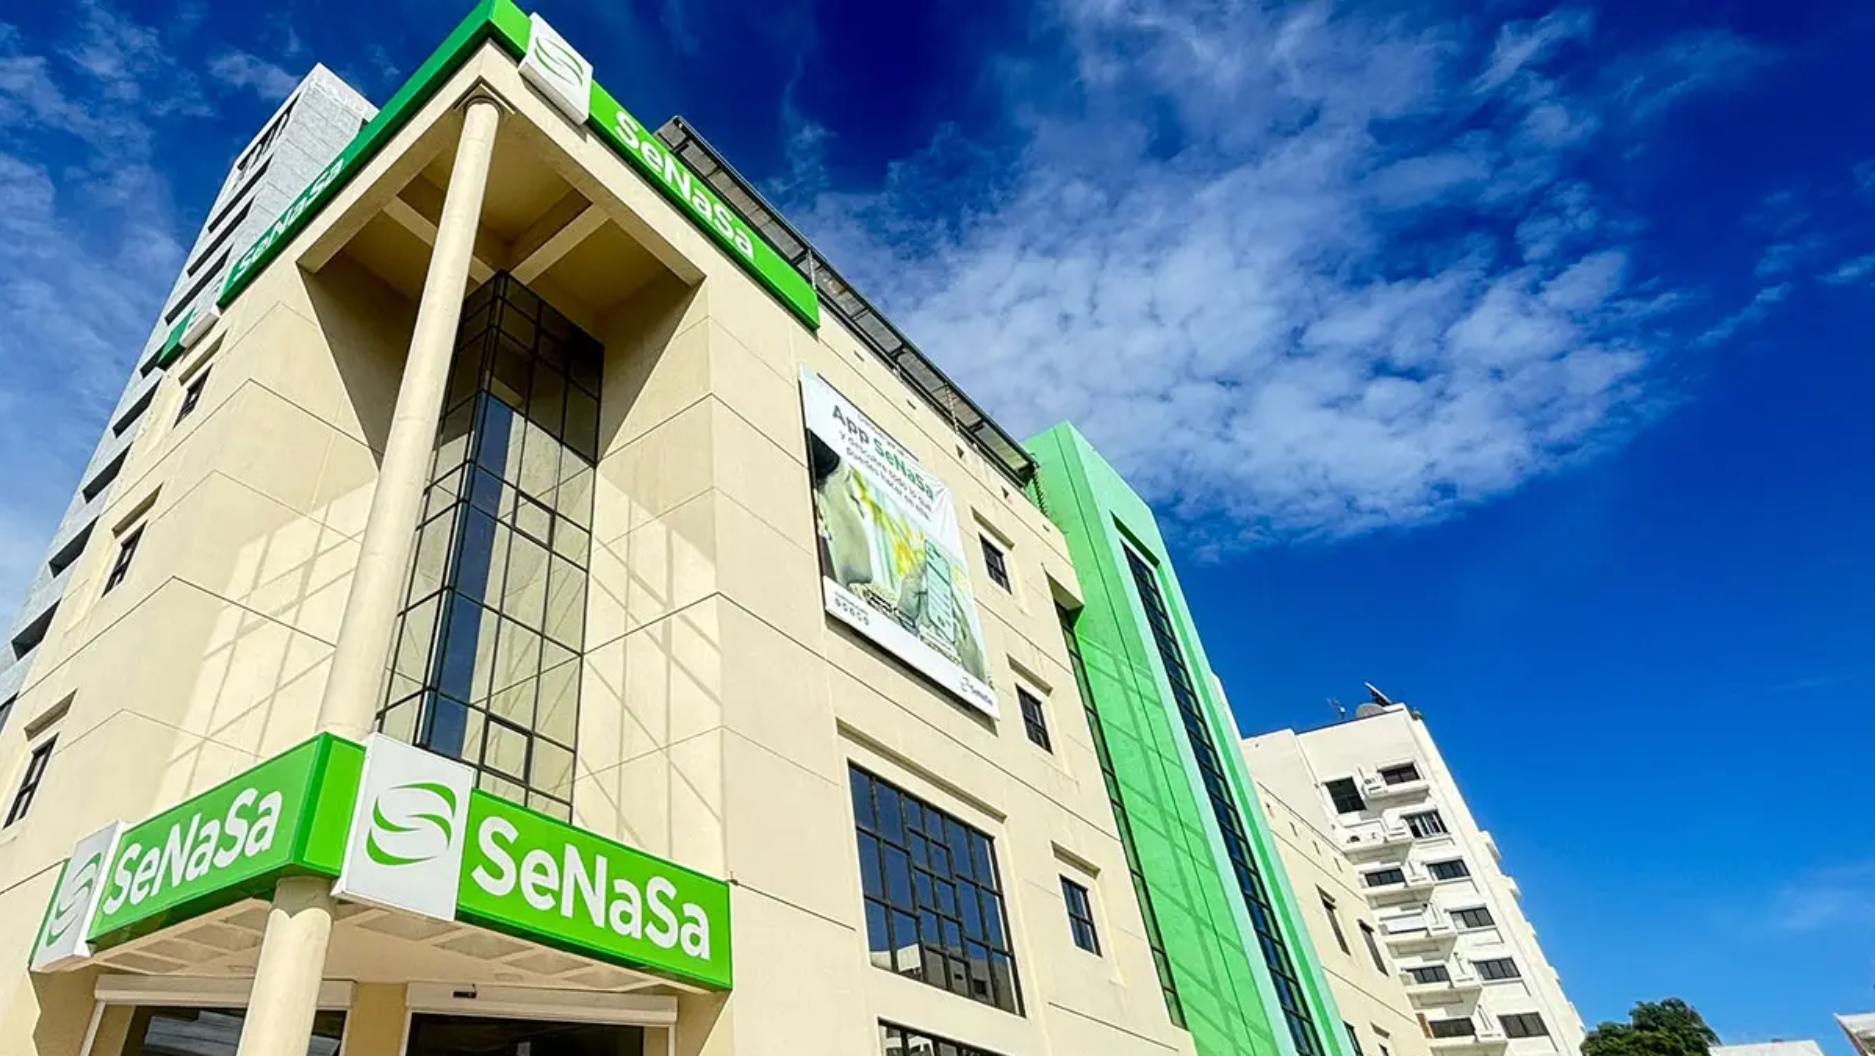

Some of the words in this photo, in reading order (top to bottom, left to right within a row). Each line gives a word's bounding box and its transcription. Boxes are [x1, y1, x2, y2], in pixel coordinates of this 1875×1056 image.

[232, 158, 344, 282] SeNaSa
[616, 110, 755, 260] SeNaSa
[832, 404, 869, 444] App
[873, 437, 935, 502] SeNaSa
[103, 788, 282, 915] SeNaSa
[472, 816, 712, 960] SeNaSa
